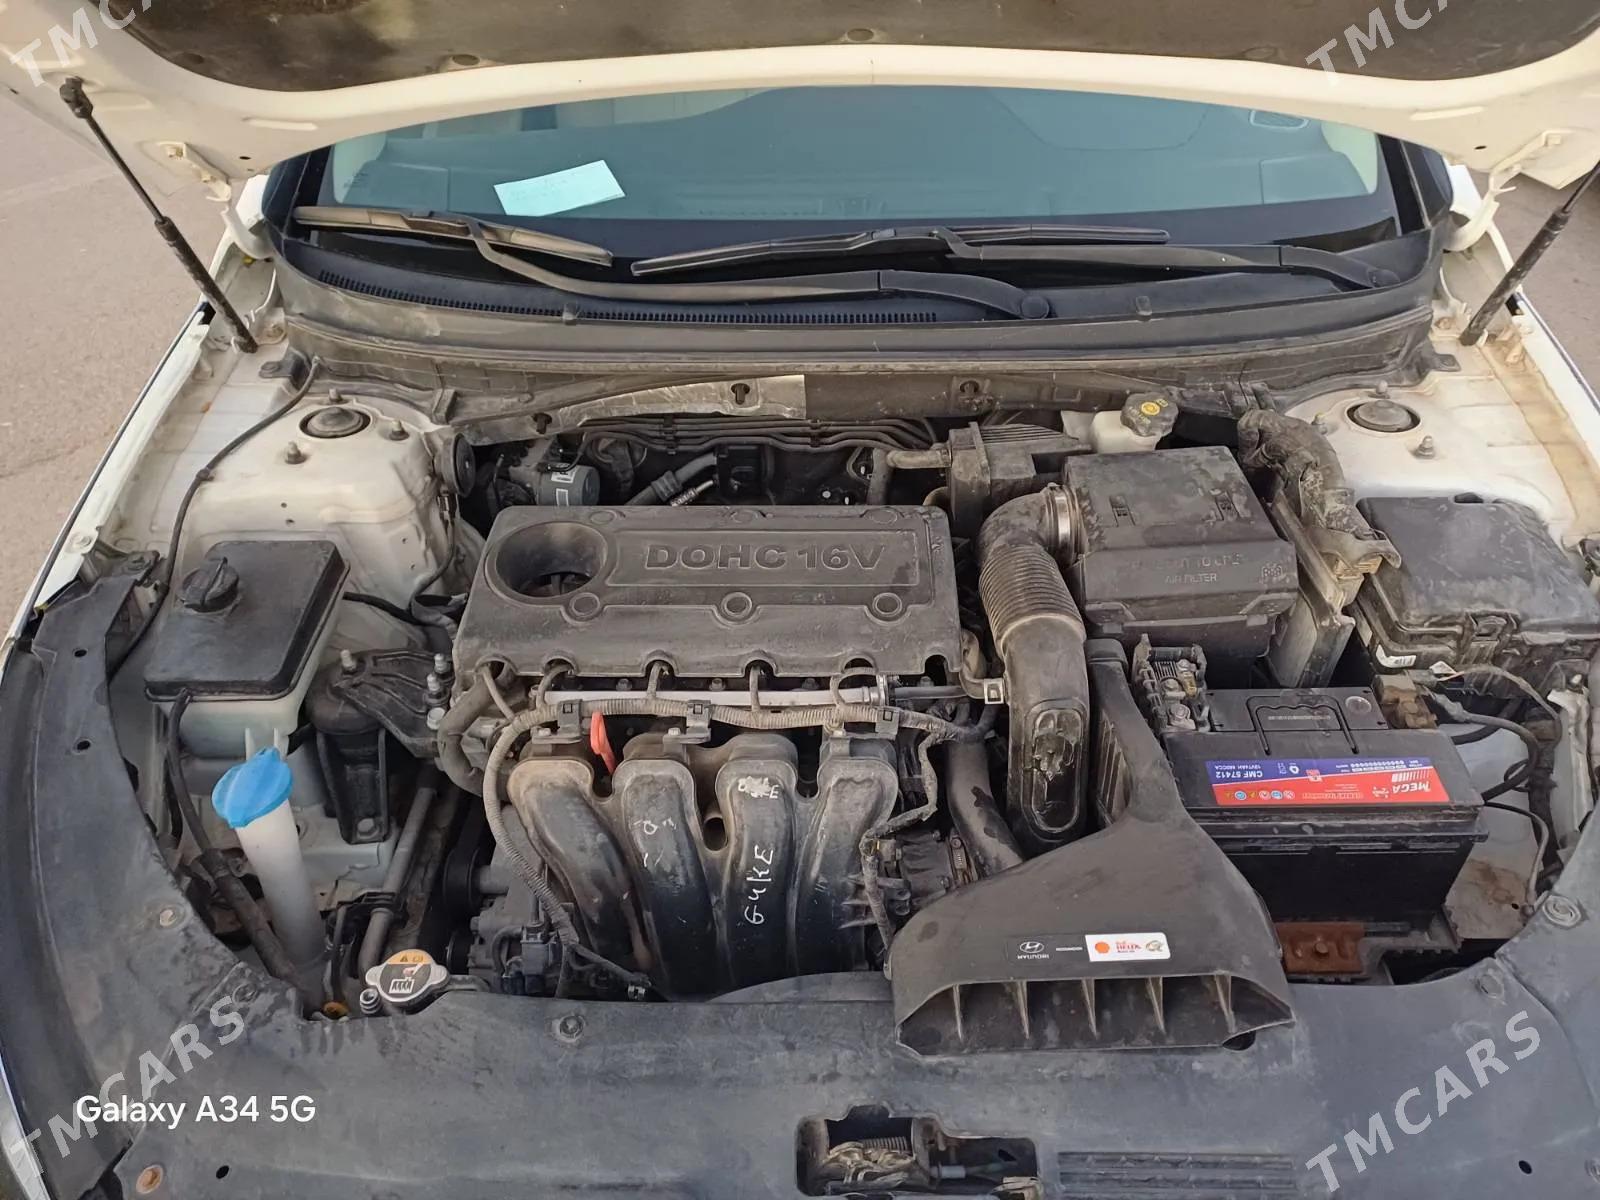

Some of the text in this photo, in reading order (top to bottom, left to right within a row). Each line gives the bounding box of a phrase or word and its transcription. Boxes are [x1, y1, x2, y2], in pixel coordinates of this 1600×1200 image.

[645, 544, 885, 570] DOHC 16V
[1242, 770, 1263, 778] CMF
[1392, 780, 1431, 793] MEGA
